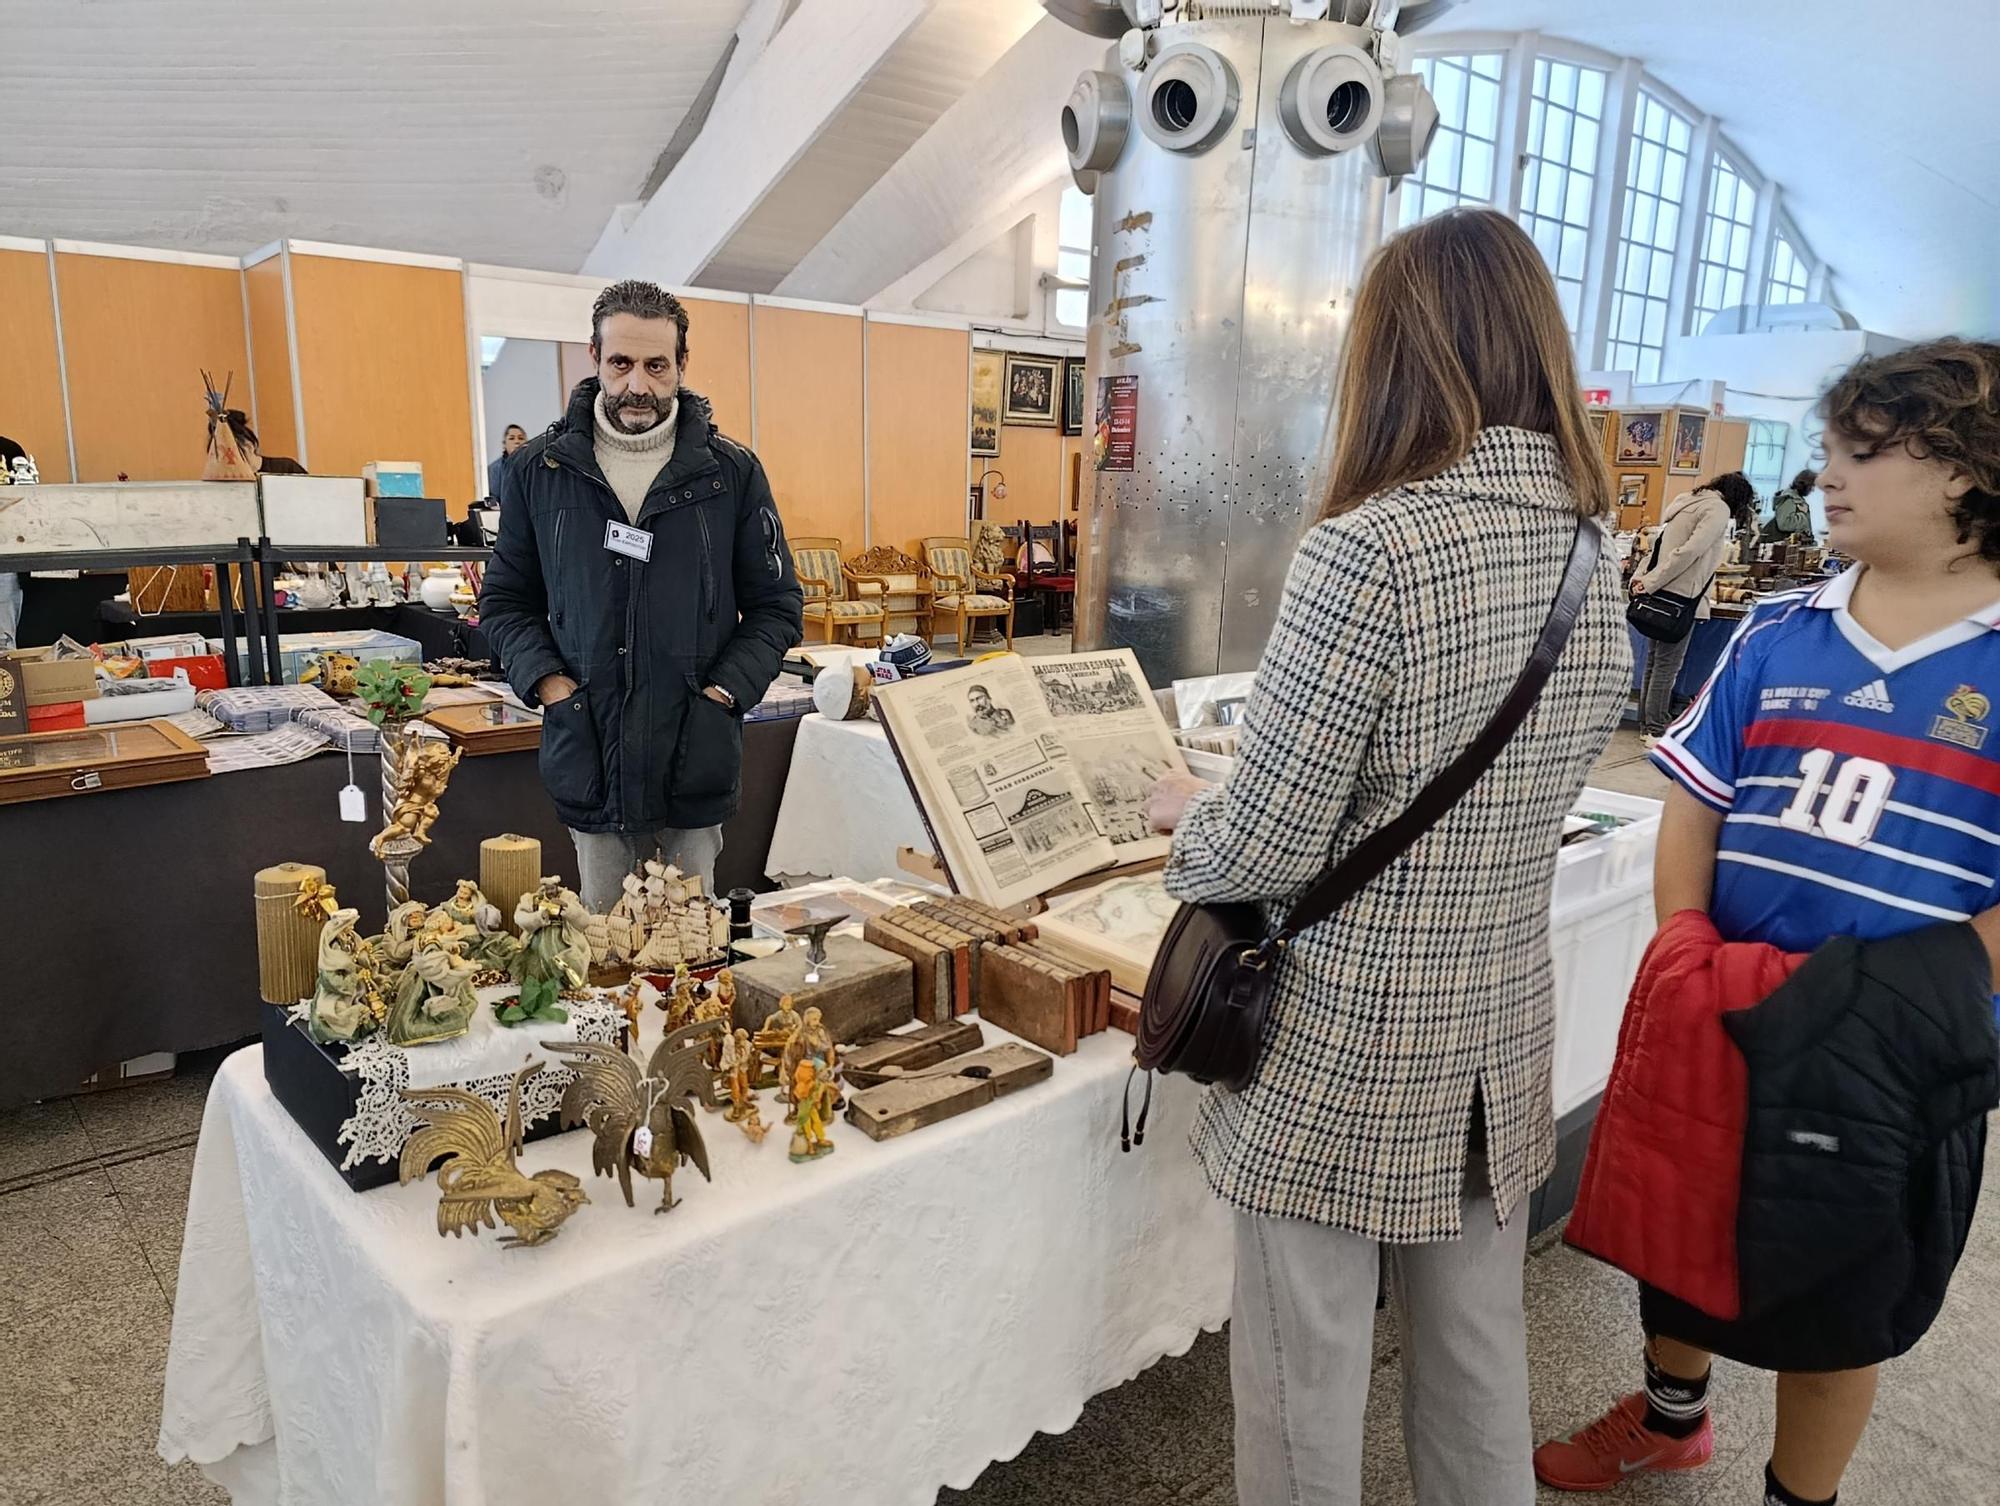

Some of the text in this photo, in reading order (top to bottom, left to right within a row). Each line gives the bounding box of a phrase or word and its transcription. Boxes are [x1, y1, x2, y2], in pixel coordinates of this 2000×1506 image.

[626, 531, 645, 543] 2025
[1843, 695, 1895, 713] adidas
[1780, 748, 1895, 846] 10
